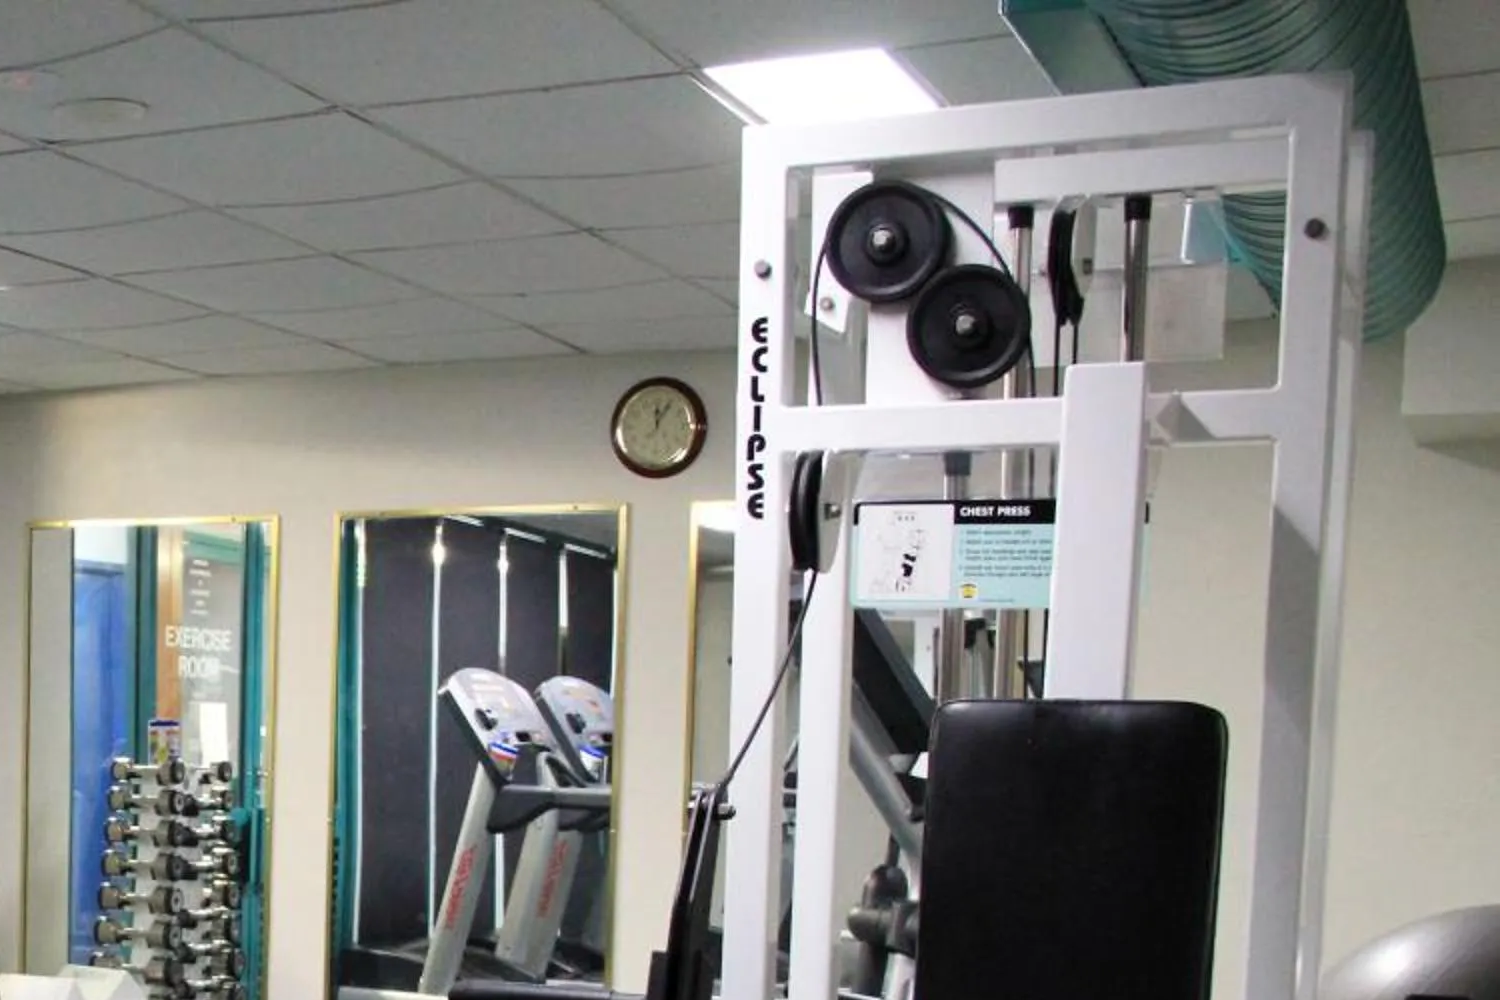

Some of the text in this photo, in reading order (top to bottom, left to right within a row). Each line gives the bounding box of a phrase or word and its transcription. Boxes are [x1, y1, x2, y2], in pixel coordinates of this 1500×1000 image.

[747, 318, 768, 520] ECLIPSE
[960, 505, 1031, 517] CHEST PRESS
